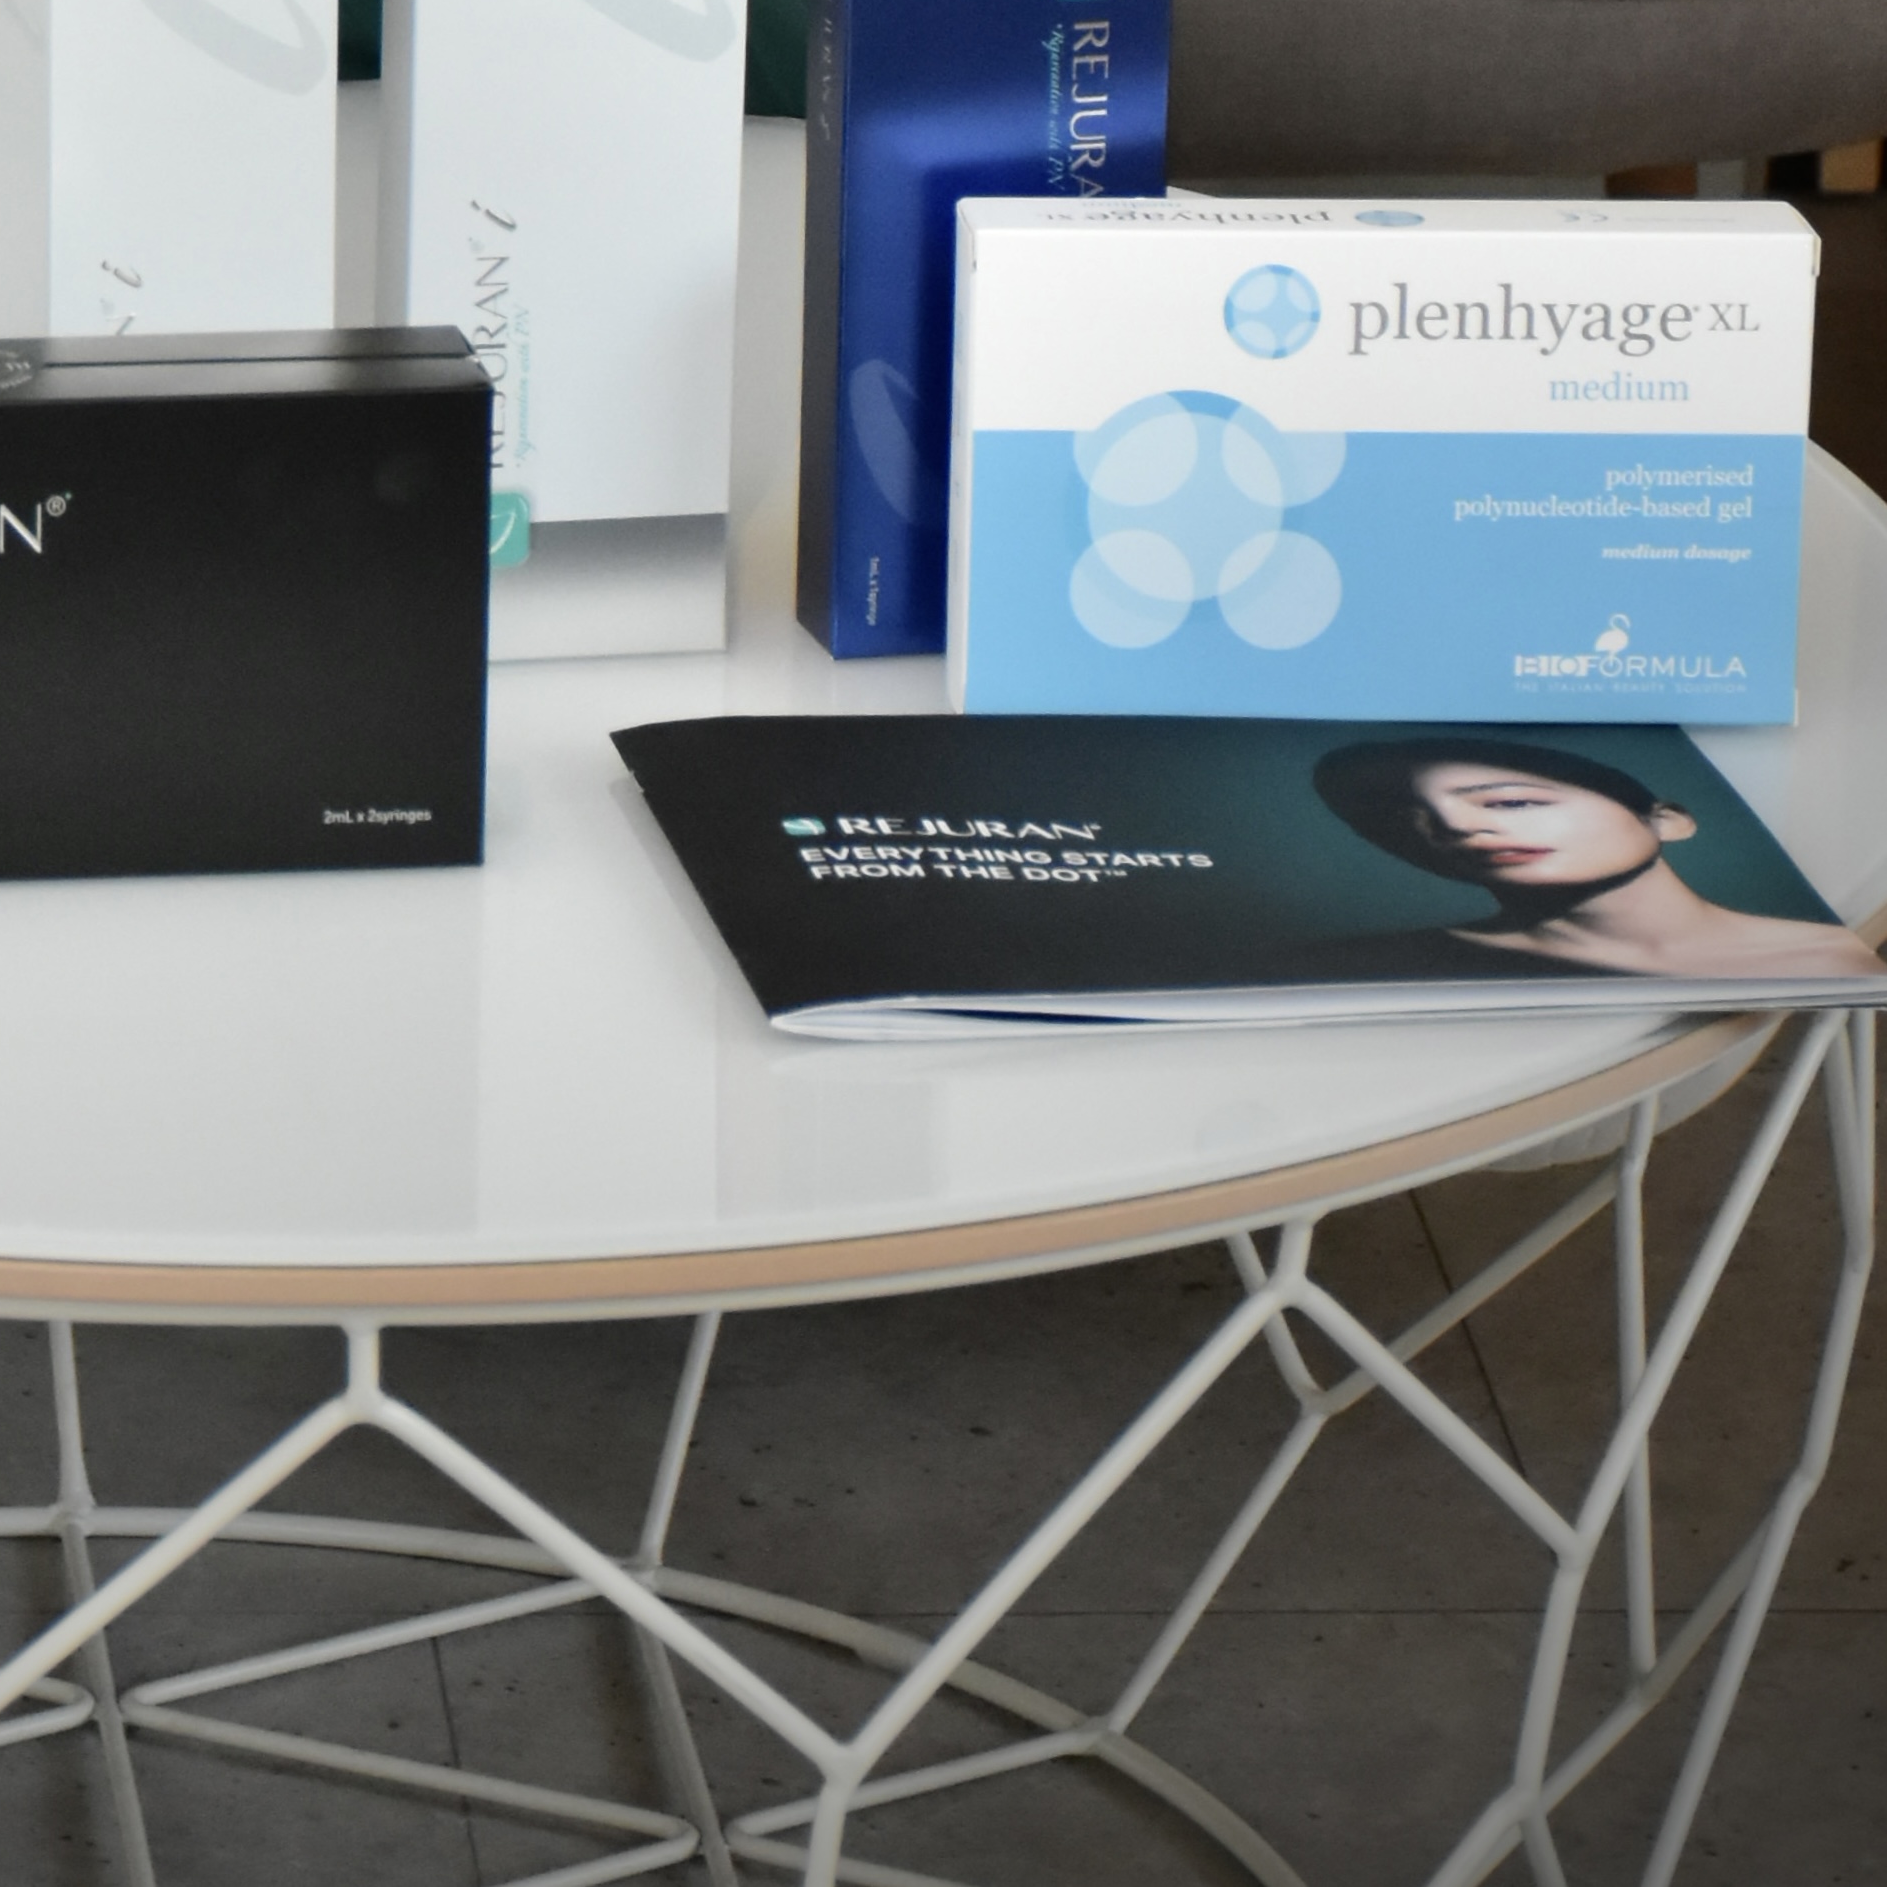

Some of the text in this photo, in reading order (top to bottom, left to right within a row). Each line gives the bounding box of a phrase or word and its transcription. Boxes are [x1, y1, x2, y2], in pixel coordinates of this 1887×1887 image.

[1069, 20, 1110, 198] REJURA
[1707, 302, 1761, 332] XL
[1548, 371, 1691, 402] medium
[1605, 463, 1754, 491] polymerised
[1454, 493, 1753, 524] polynucleotide-based gel
[1601, 543, 1752, 563] medium dosage
[1515, 654, 1748, 678] BIOFORMULA
[323, 807, 432, 826] 2mL x 2syringes
[800, 846, 1214, 868] EVERYTHING STARTS
[810, 864, 926, 881] FROM
[933, 863, 1015, 881] THE
